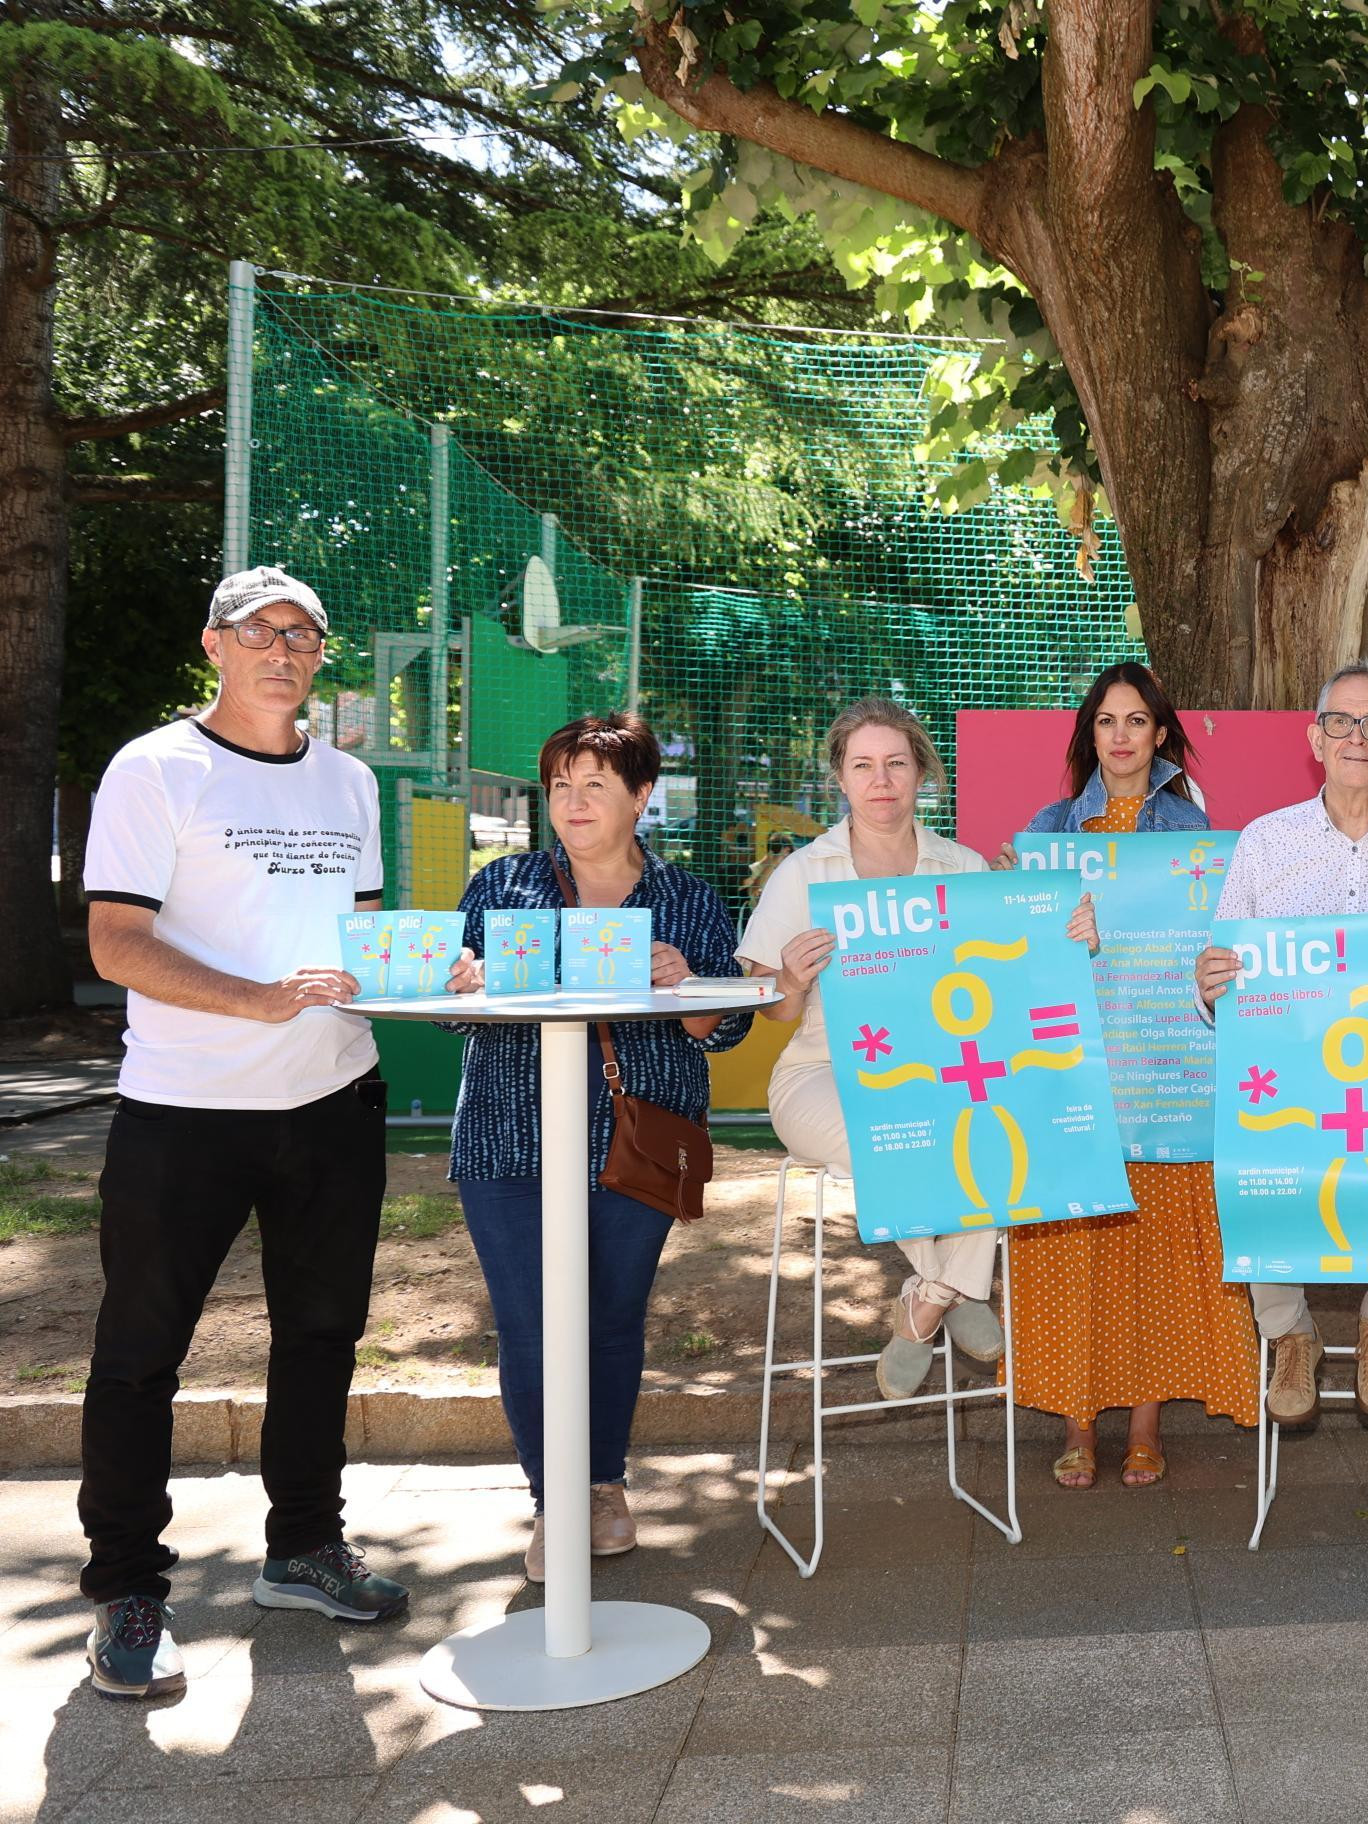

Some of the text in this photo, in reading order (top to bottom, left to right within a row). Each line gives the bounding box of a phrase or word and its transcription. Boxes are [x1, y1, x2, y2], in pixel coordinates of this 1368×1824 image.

[225, 828, 233, 837] O
[237, 828, 262, 836] único
[234, 839, 281, 850] principiar
[253, 852, 268, 860] que
[286, 852, 315, 860] diante
[318, 851, 329, 859] do
[267, 861, 346, 875] Xurxo Souto
[1003, 893, 1026, 905] 11-14
[1029, 904, 1053, 915] 2024
[399, 916, 422, 930] plic!
[491, 914, 514, 930] plic!
[568, 912, 598, 926] plic!
[833, 884, 949, 950] plic!
[345, 916, 375, 932] plic!
[1113, 930, 1166, 941] Orquestra
[1174, 942, 1194, 952] Xan
[840, 946, 929, 966] praza dos libros
[1233, 928, 1347, 990] plic!
[842, 963, 889, 977] carballo
[1118, 985, 1183, 997] Miguel Anxo
[1237, 988, 1324, 1005] praza dos libros
[1238, 1005, 1283, 1018] carballo
[1107, 1014, 1181, 1024] Cousillas Lupe
[1140, 1028, 1165, 1039] Olga
[1127, 1069, 1208, 1082] Ninghures Paco
[1157, 1084, 1188, 1094] Rober
[1083, 1104, 1093, 1112] da
[1150, 1112, 1192, 1123] Castaño
